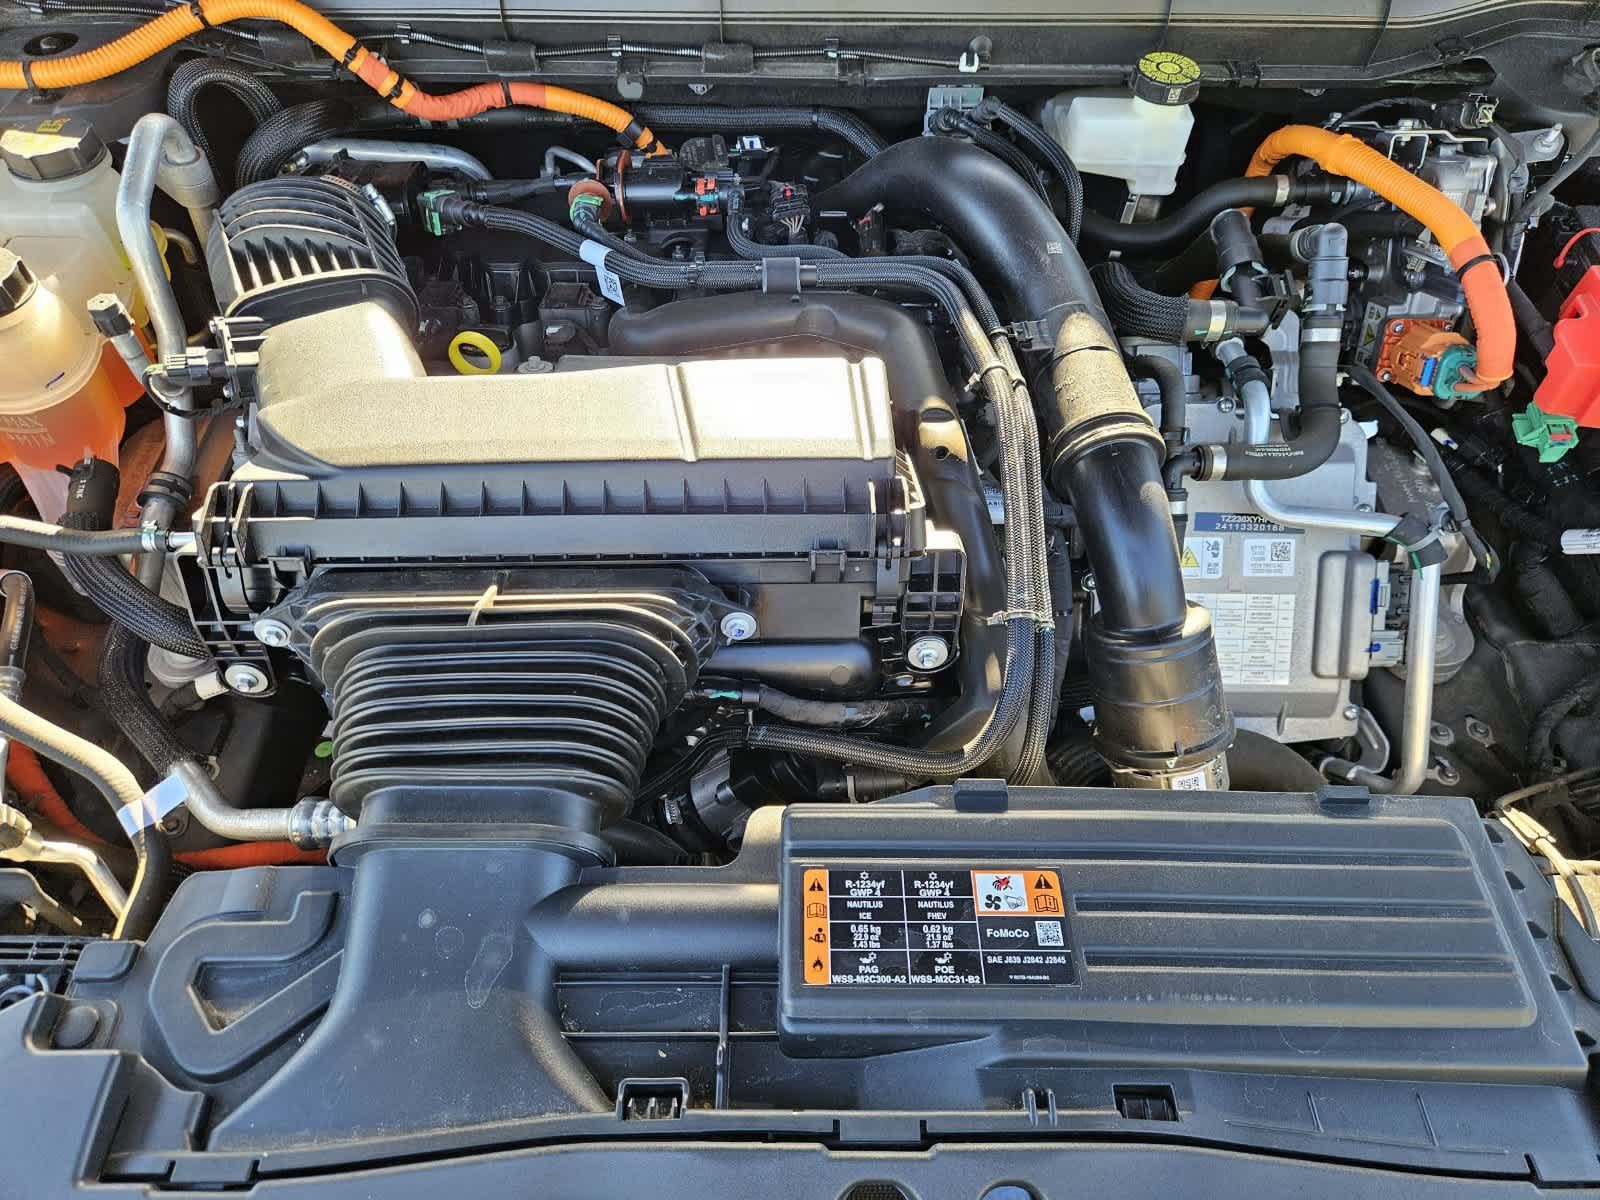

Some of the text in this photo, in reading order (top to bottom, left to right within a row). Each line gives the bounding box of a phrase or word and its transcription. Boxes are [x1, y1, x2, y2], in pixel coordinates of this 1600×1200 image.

[845, 880, 885, 890] R-1234yf
[846, 900, 884, 909] NAUTILUS
[917, 900, 954, 909] NAUTILUS
[859, 912, 872, 920] ICE
[927, 912, 947, 920] FHEV
[850, 924, 881, 935] 0.65 kg
[922, 924, 954, 935] 0.62 kg
[986, 928, 1030, 938] FoMoCo
[869, 940, 881, 948] lbs
[941, 940, 954, 948] lbs
[987, 955, 1003, 964] SAE
[859, 966, 879, 974] PAG
[934, 965, 955, 974] POE
